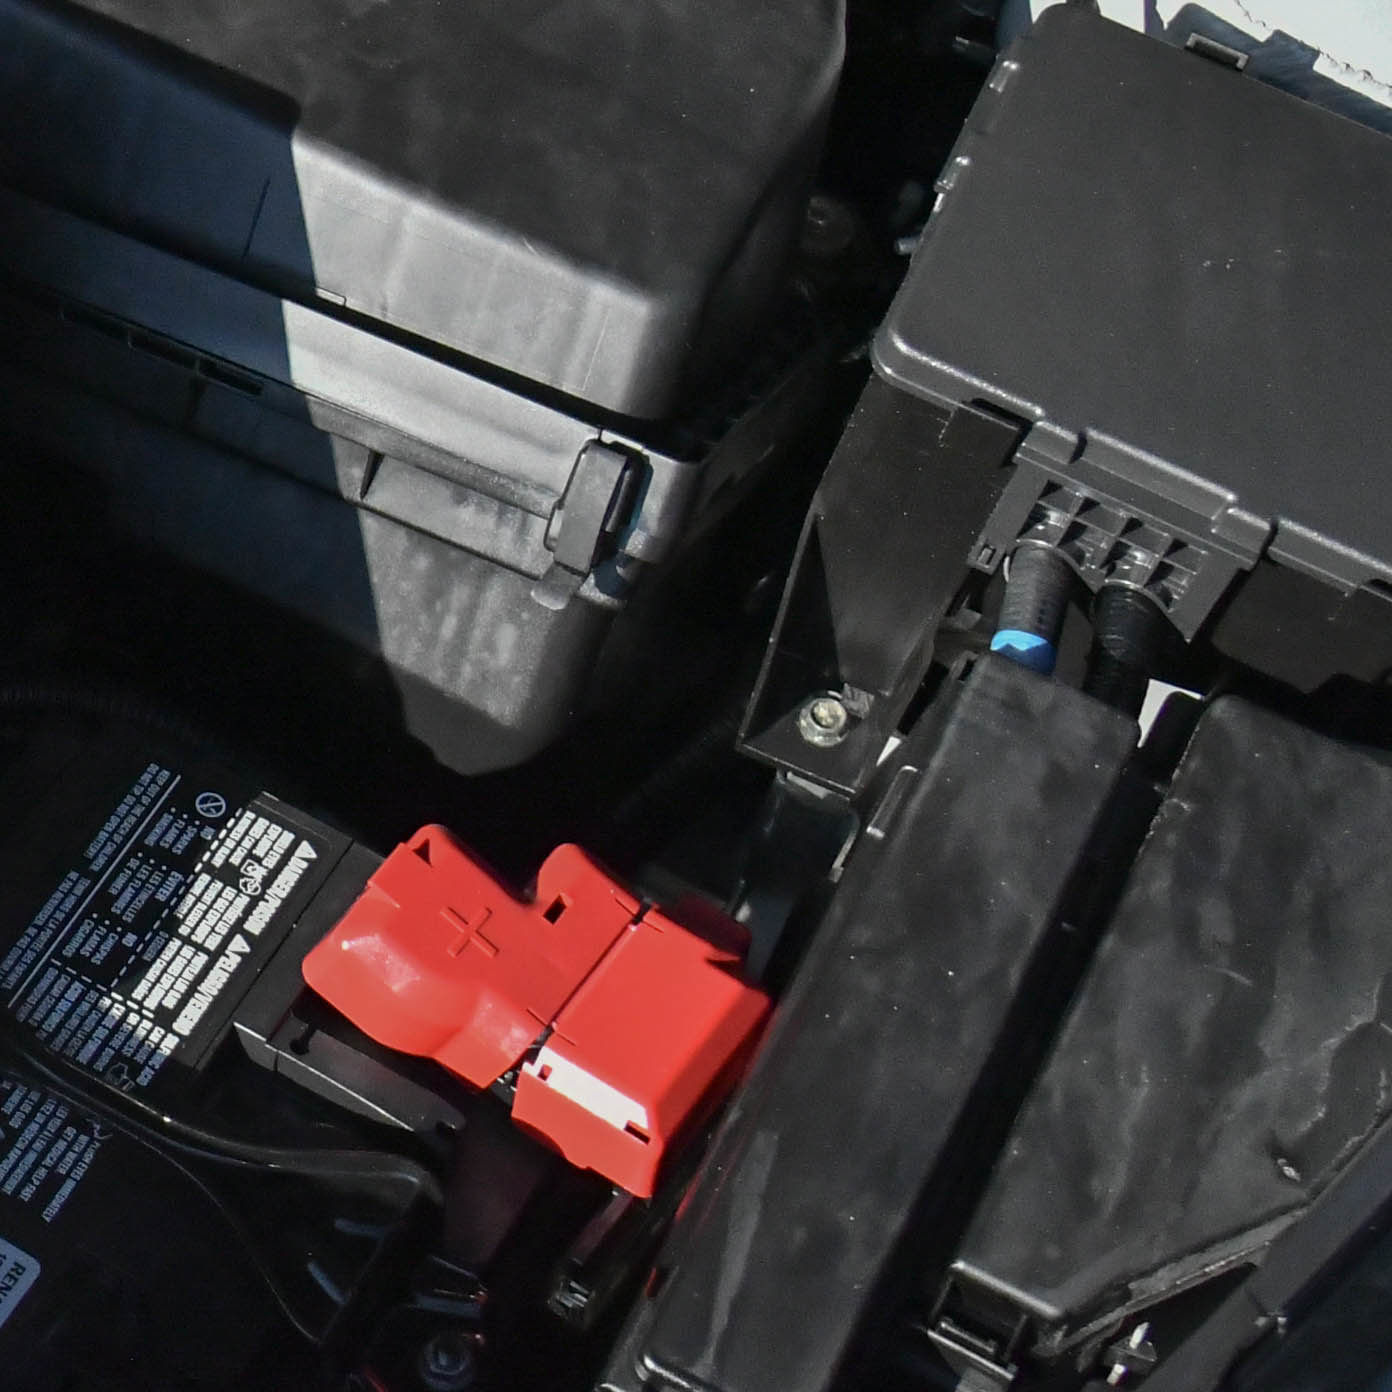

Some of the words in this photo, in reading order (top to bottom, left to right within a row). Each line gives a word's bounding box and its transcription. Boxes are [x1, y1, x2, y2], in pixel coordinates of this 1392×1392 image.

[159, 818, 185, 848] FLAMES
[171, 825, 197, 854] SPARKS
[126, 857, 140, 870] DE
[135, 864, 152, 880] LES
[107, 868, 132, 895] FUMER
[148, 870, 164, 885] LES
[110, 878, 141, 914] FLAMMES
[243, 856, 307, 934] DANGER/POISON
[62, 919, 94, 957] CIGARROS
[79, 925, 107, 956] FLAMAS
[90, 932, 118, 964] CHISPAS
[172, 950, 240, 1035] PELIGRO/VENENO
[126, 1012, 140, 1025] OR
[108, 1022, 133, 1049] SEVERE
[148, 1026, 165, 1043] CAN
[133, 1039, 155, 1064] CAUSE
[135, 1065, 154, 1086] ACID
[31, 1166, 48, 1185] HELP
